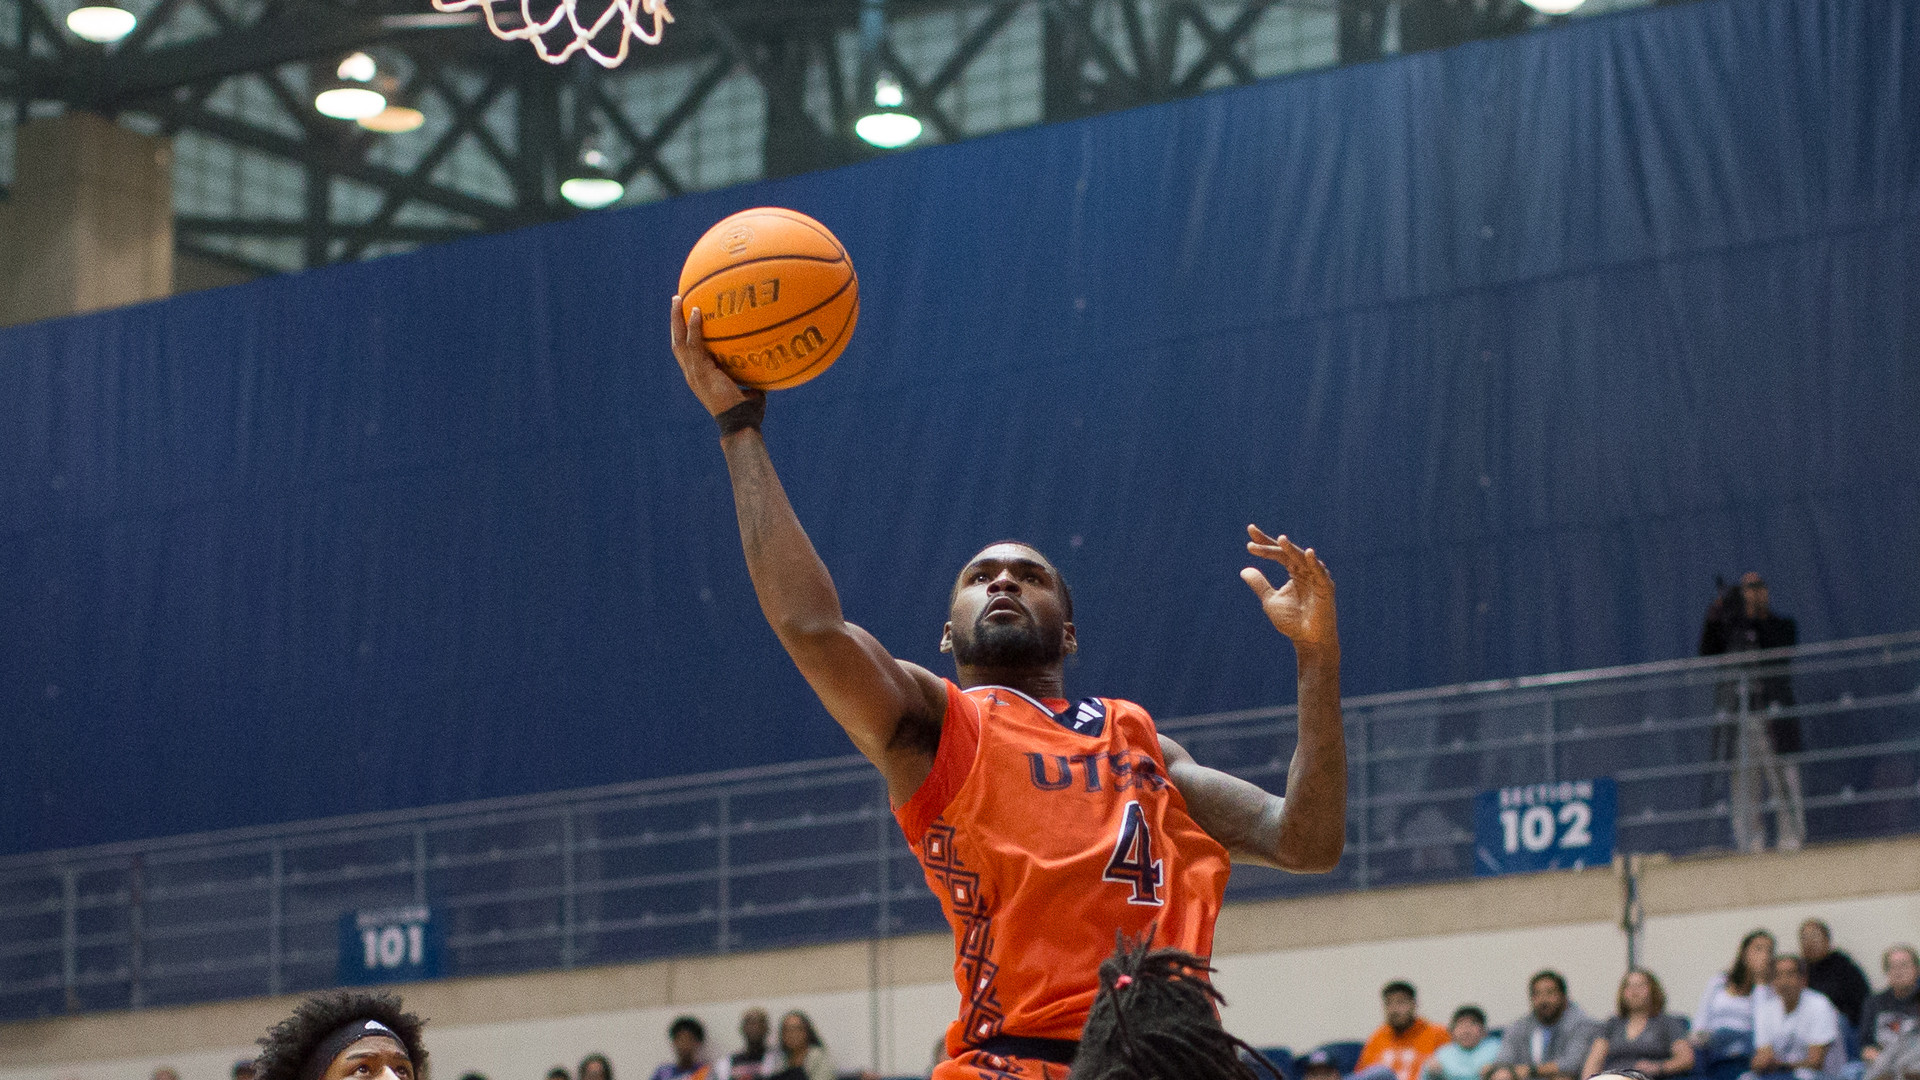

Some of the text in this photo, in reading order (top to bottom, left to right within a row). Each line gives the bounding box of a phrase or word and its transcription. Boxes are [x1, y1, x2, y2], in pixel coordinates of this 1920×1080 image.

[715, 277, 780, 319] EVO
[1499, 800, 1593, 854] 102
[1102, 800, 1164, 906] 4
[361, 920, 423, 969] 101
